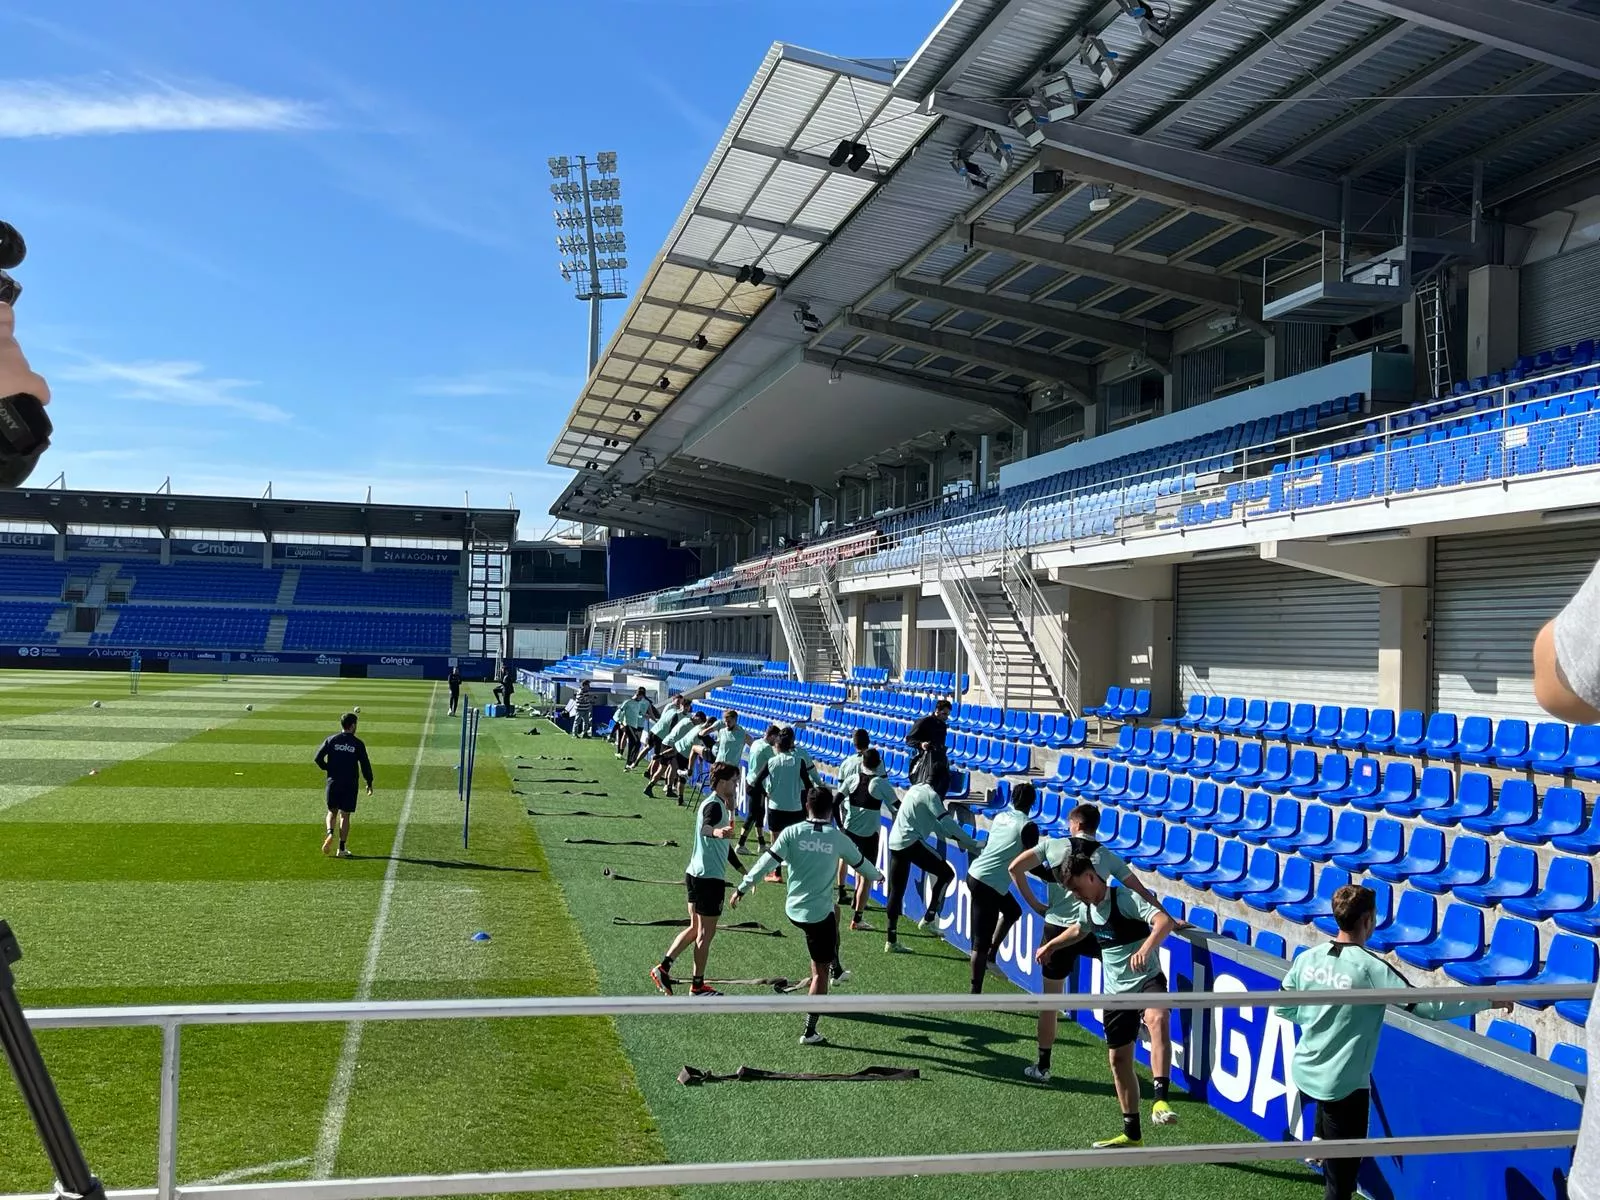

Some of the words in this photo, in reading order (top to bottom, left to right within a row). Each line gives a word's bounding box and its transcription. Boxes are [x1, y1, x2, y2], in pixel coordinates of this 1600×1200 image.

[191, 541, 244, 554] embou
[334, 743, 356, 753] soka
[799, 839, 833, 854] soka
[1303, 964, 1352, 990] soka
